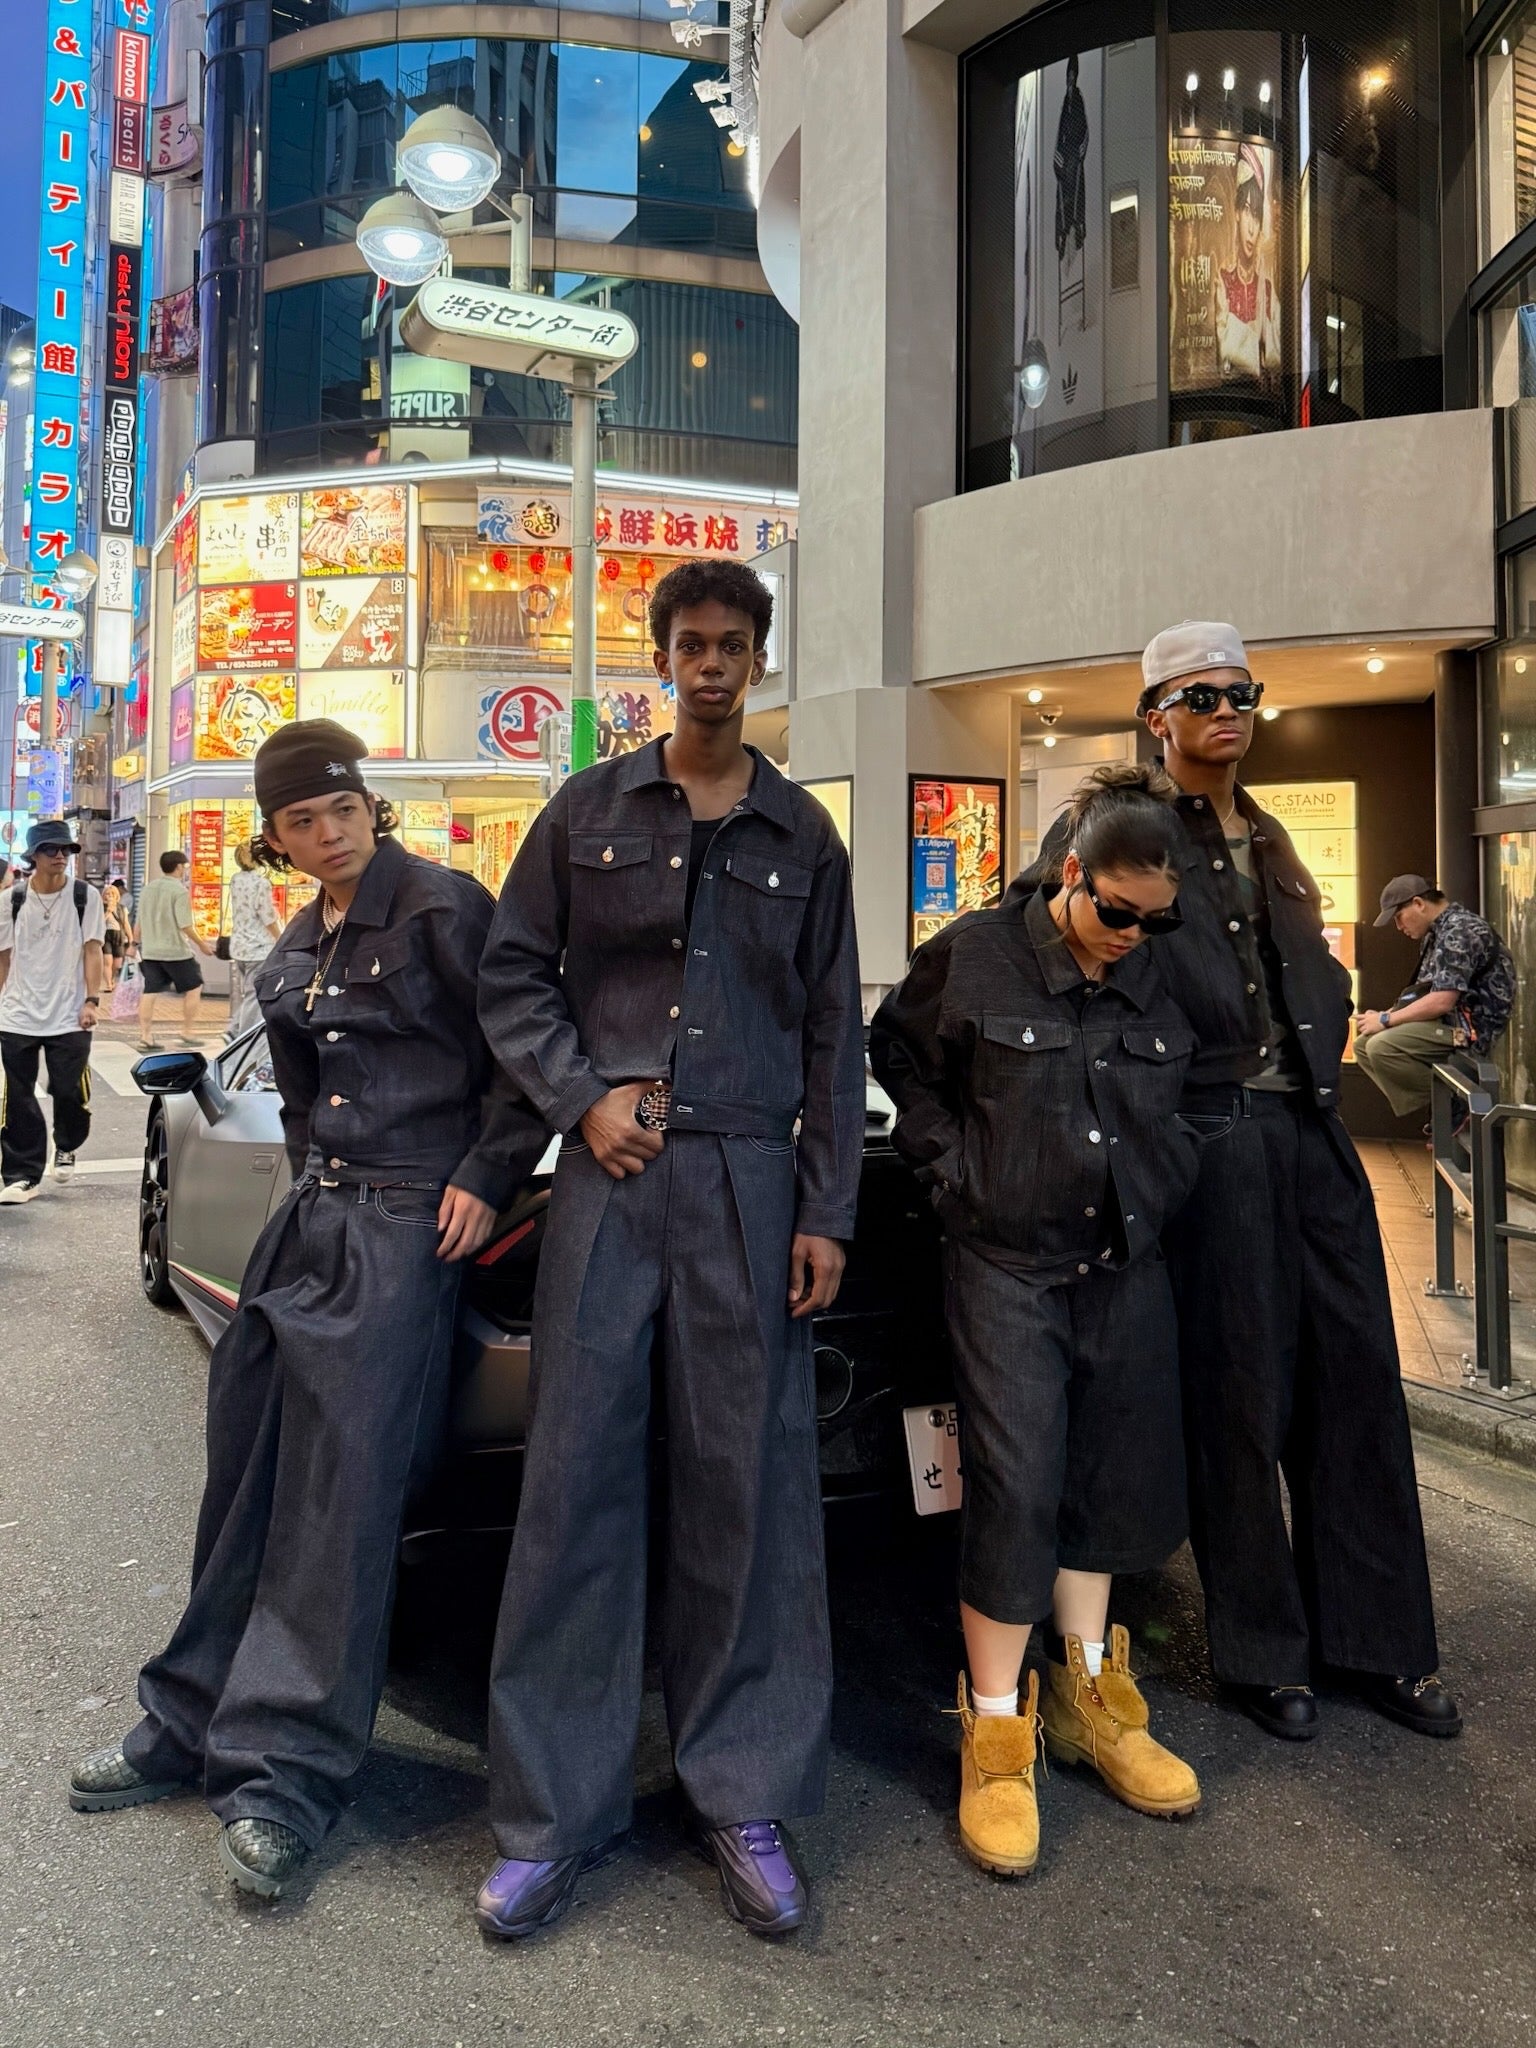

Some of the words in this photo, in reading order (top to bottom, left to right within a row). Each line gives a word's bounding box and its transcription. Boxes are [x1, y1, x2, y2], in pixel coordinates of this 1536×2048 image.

[125, 39, 140, 98] kimono
[122, 107, 137, 163] hearts
[117, 254, 131, 297] disk
[437, 294, 623, 346] 渋谷センター街
[115, 299, 134, 379] union
[395, 487, 403, 500] 9
[288, 496, 298, 508] 6
[287, 584, 296, 598] 5
[393, 579, 403, 593] 8
[286, 677, 295, 688] 4
[393, 672, 401, 684] 7
[1272, 793, 1336, 807] C.STAND
[923, 1462, 942, 1489] せ
